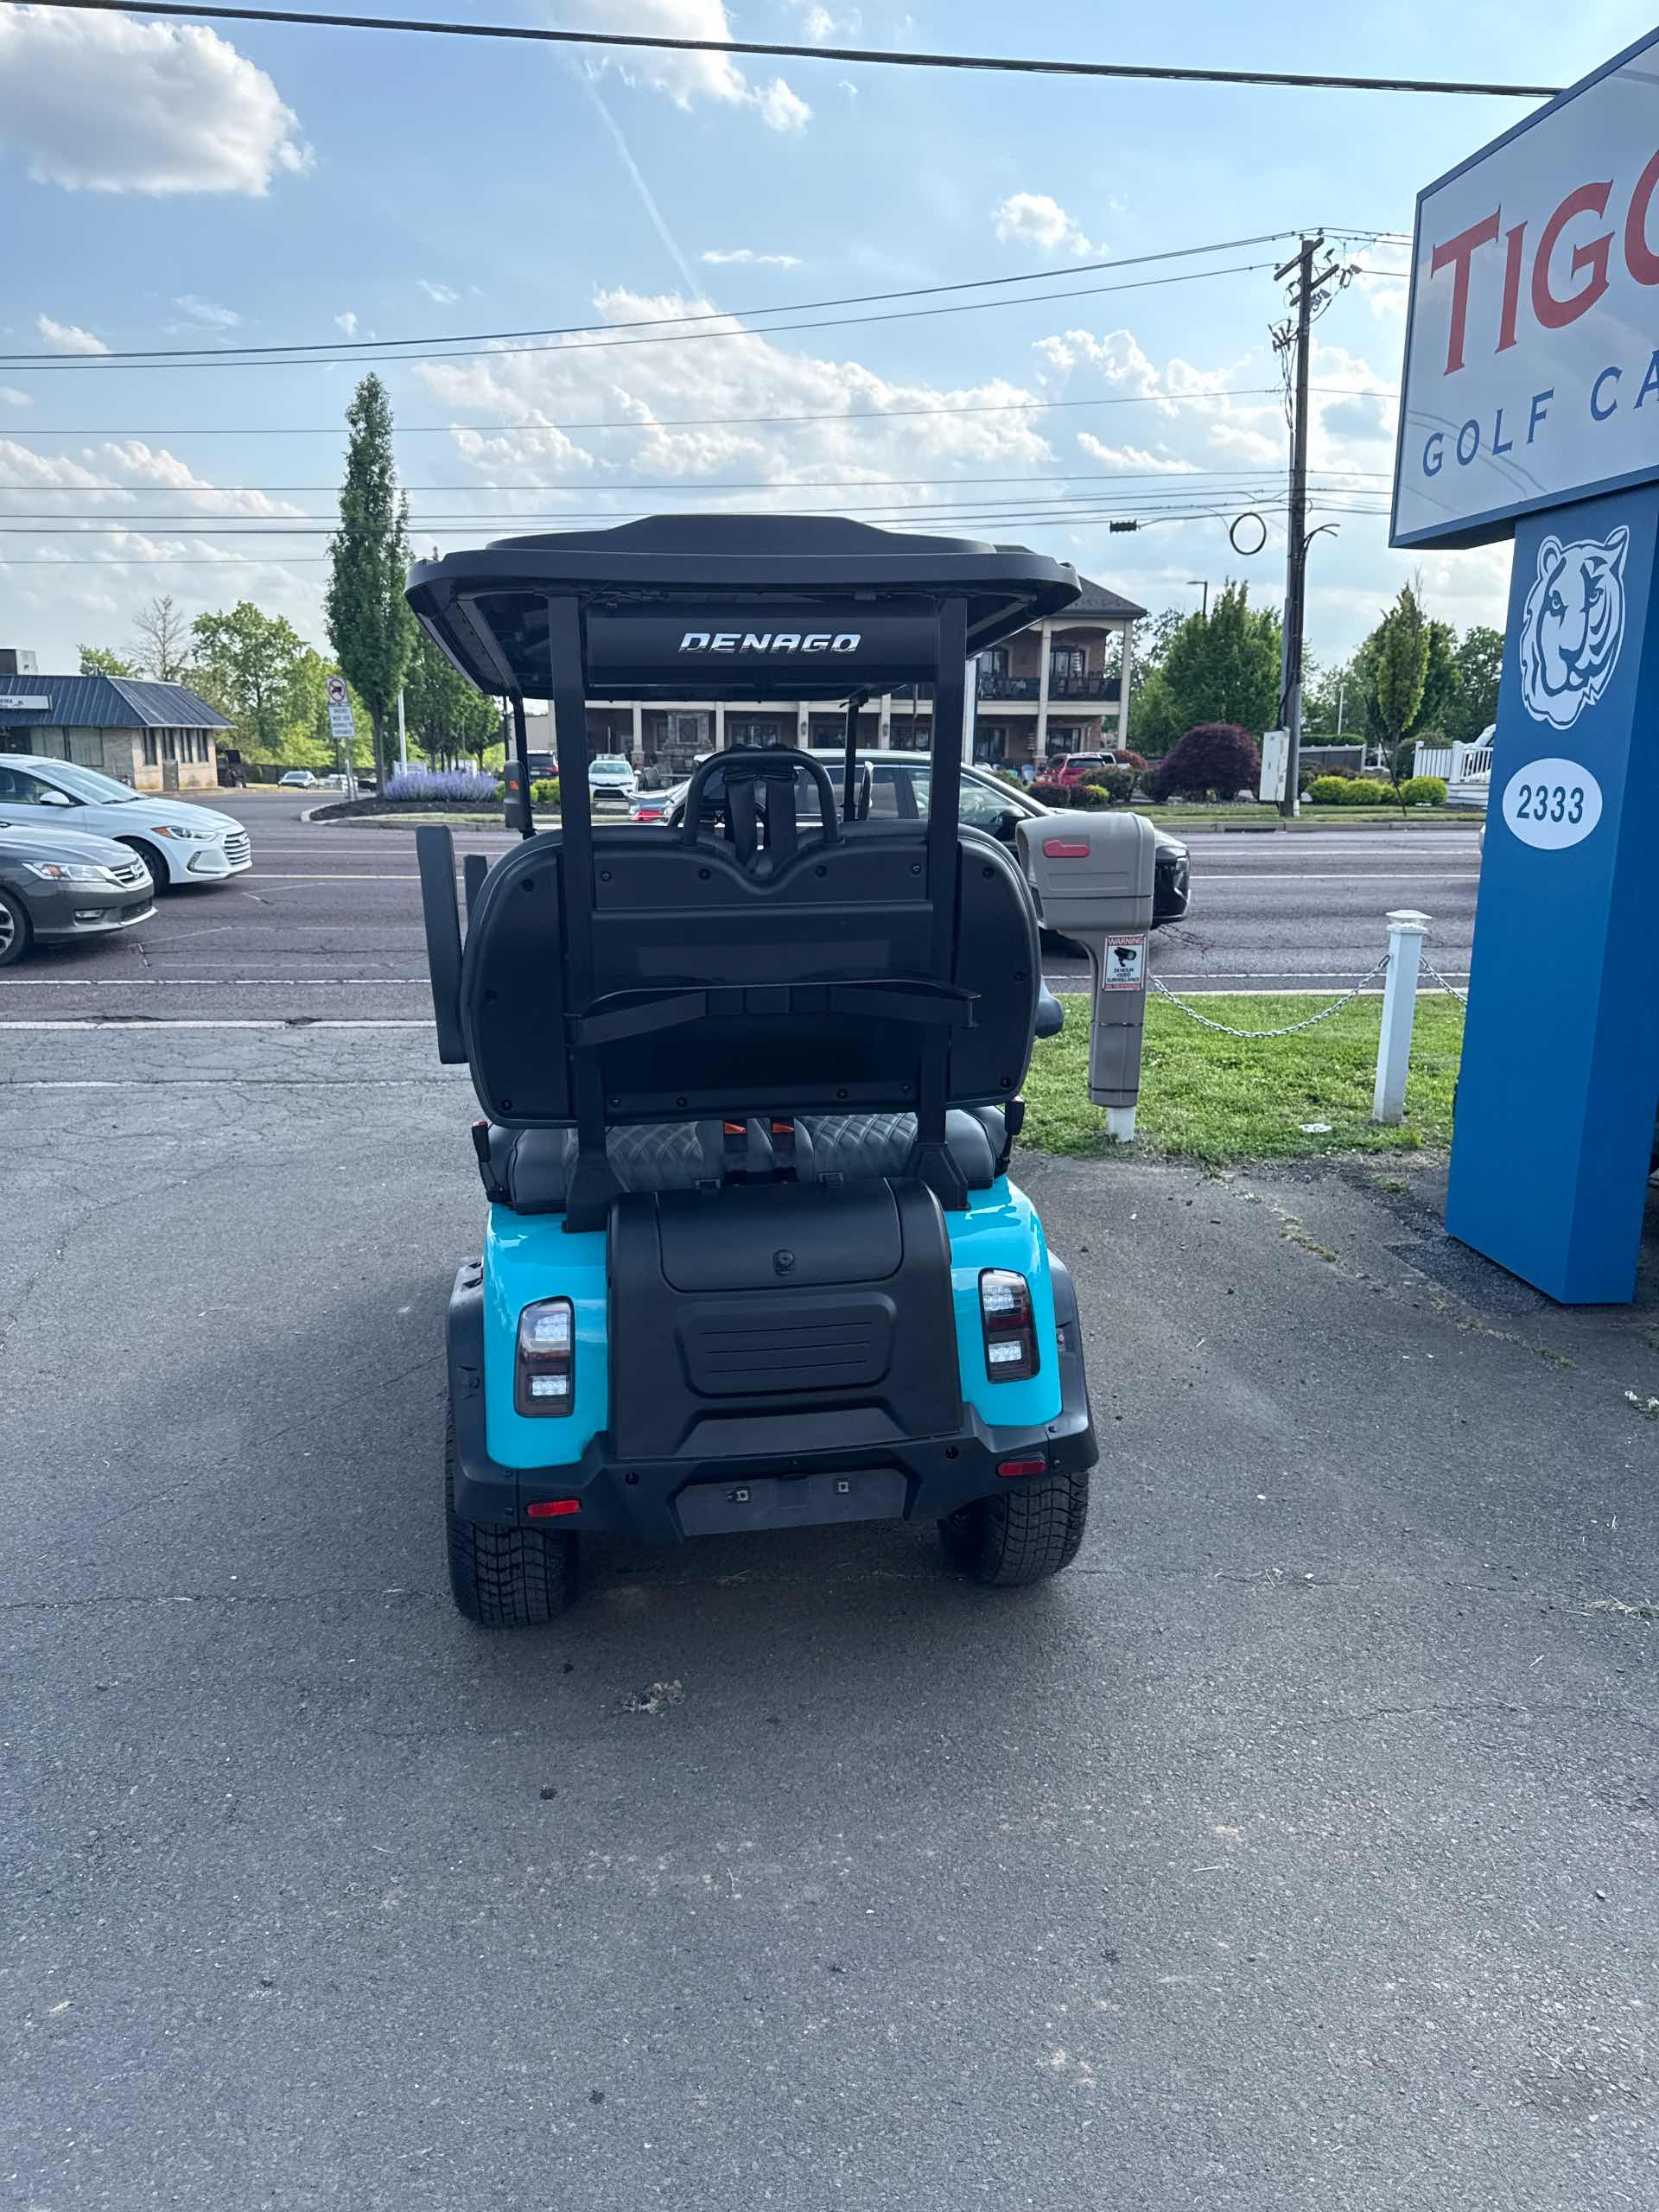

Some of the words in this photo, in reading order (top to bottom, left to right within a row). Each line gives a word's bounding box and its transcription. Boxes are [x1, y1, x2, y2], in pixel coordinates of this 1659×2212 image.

[1422, 387, 1554, 477] GOLF
[678, 632, 861, 653] DENAGO
[1516, 784, 1585, 824] 2333
[1108, 937, 1144, 945] WARNING
